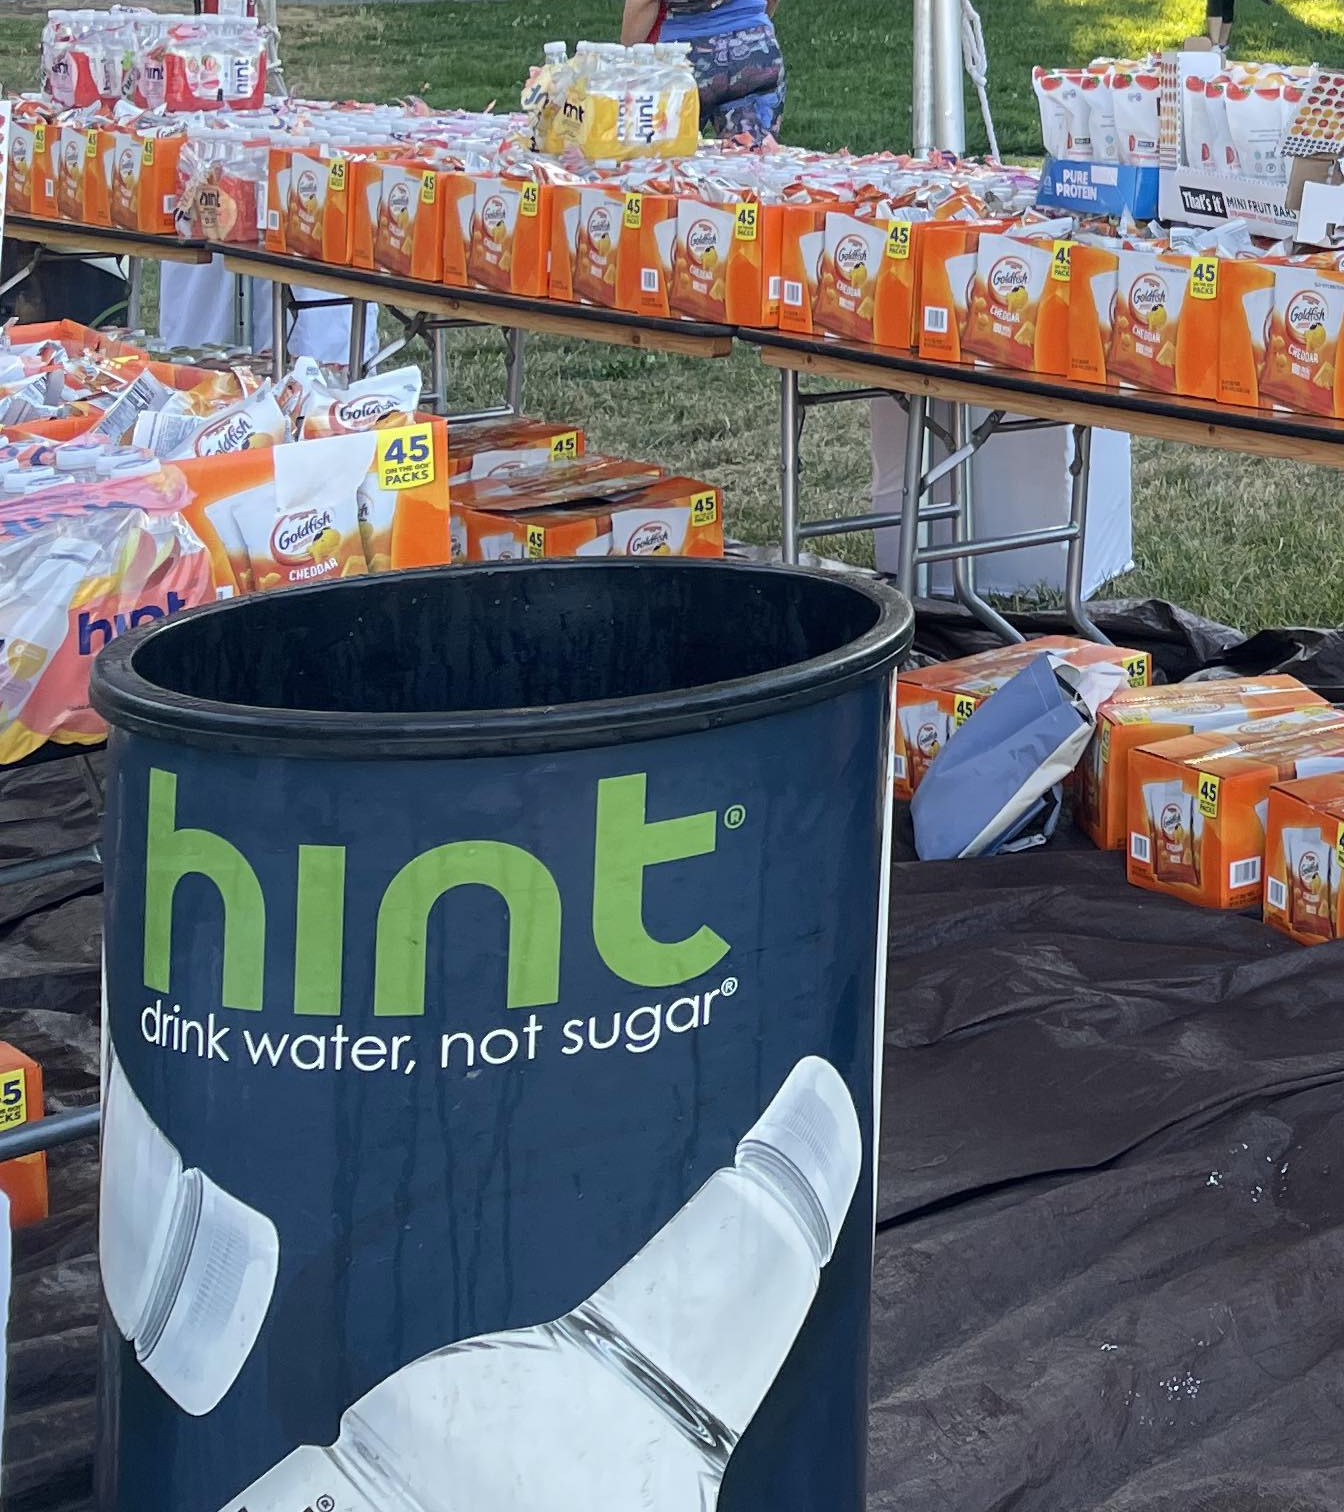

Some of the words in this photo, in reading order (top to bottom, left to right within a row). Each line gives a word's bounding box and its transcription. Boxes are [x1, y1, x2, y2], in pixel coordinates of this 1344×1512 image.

[330, 164, 344, 177] 45
[1063, 169, 1088, 185] PURE
[423, 177, 434, 189] 45
[1056, 182, 1098, 201] PROTEIN
[523, 187, 537, 202] 45
[627, 198, 641, 214] 45
[1182, 190, 1212, 212] That's
[1226, 196, 1247, 209] MINI
[1247, 199, 1273, 215] FRUIT
[1273, 204, 1298, 220] BARS
[737, 209, 755, 225] 45
[690, 232, 717, 246] Goldfish
[889, 227, 909, 244] 45
[838, 246, 868, 263] Goldfish
[993, 267, 1029, 286] Goldfish
[1193, 263, 1216, 282] 45
[1133, 288, 1167, 306] Goldfish
[1290, 304, 1326, 322] Goldfish
[384, 434, 430, 465] 45
[554, 436, 575, 452] 45
[385, 467, 398, 475] ON
[399, 465, 414, 473] THE
[385, 470, 430, 486] PACKS
[694, 496, 715, 512] 45
[278, 510, 333, 551] Goldfish
[529, 531, 543, 547] 45
[289, 557, 338, 582] CHEDDAR
[1126, 660, 1145, 677] 45
[956, 700, 973, 718] 45
[1200, 781, 1217, 802] 45
[140, 999, 230, 1062] drink
[243, 1021, 417, 1075] water,
[441, 1013, 543, 1069] not
